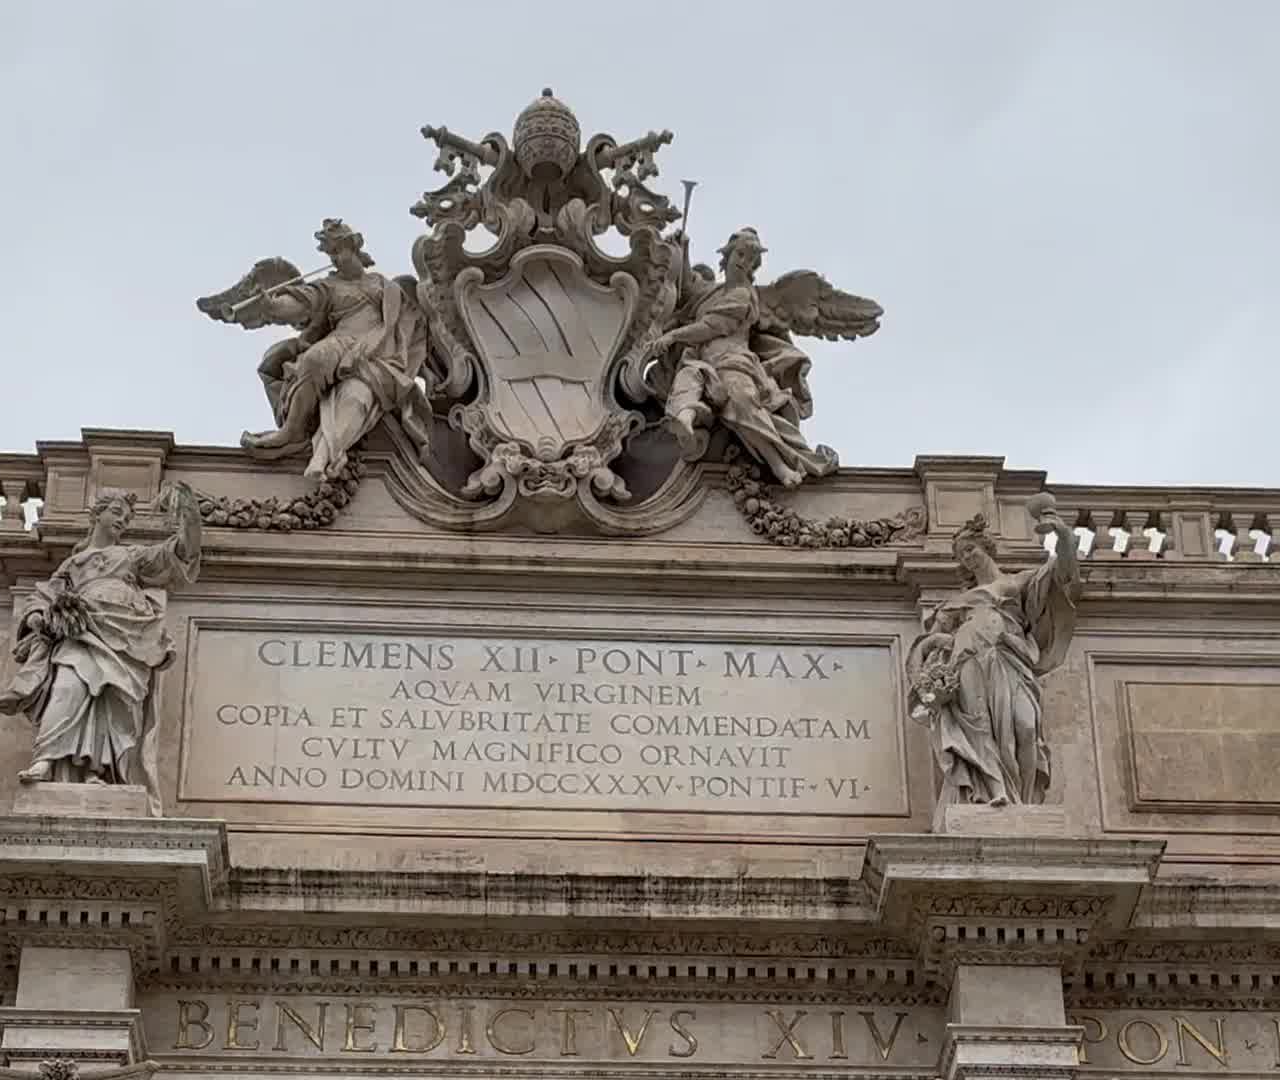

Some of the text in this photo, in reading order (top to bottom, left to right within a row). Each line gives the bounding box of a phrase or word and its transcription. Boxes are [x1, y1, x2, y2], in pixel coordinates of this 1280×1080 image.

[258, 640, 455, 670] CLEMENS
[390, 680, 702, 706] AQVAM VIRGINEM
[216, 705, 871, 740] COPIA ET SALVBRITATE COMMENDATAM
[301, 737, 791, 768] CVLTV MAGNIFICO ORNAVIT
[225, 766, 327, 788] ANNO
[340, 769, 464, 792] DOMINI
[173, 999, 698, 1058] BENEDICTVS
